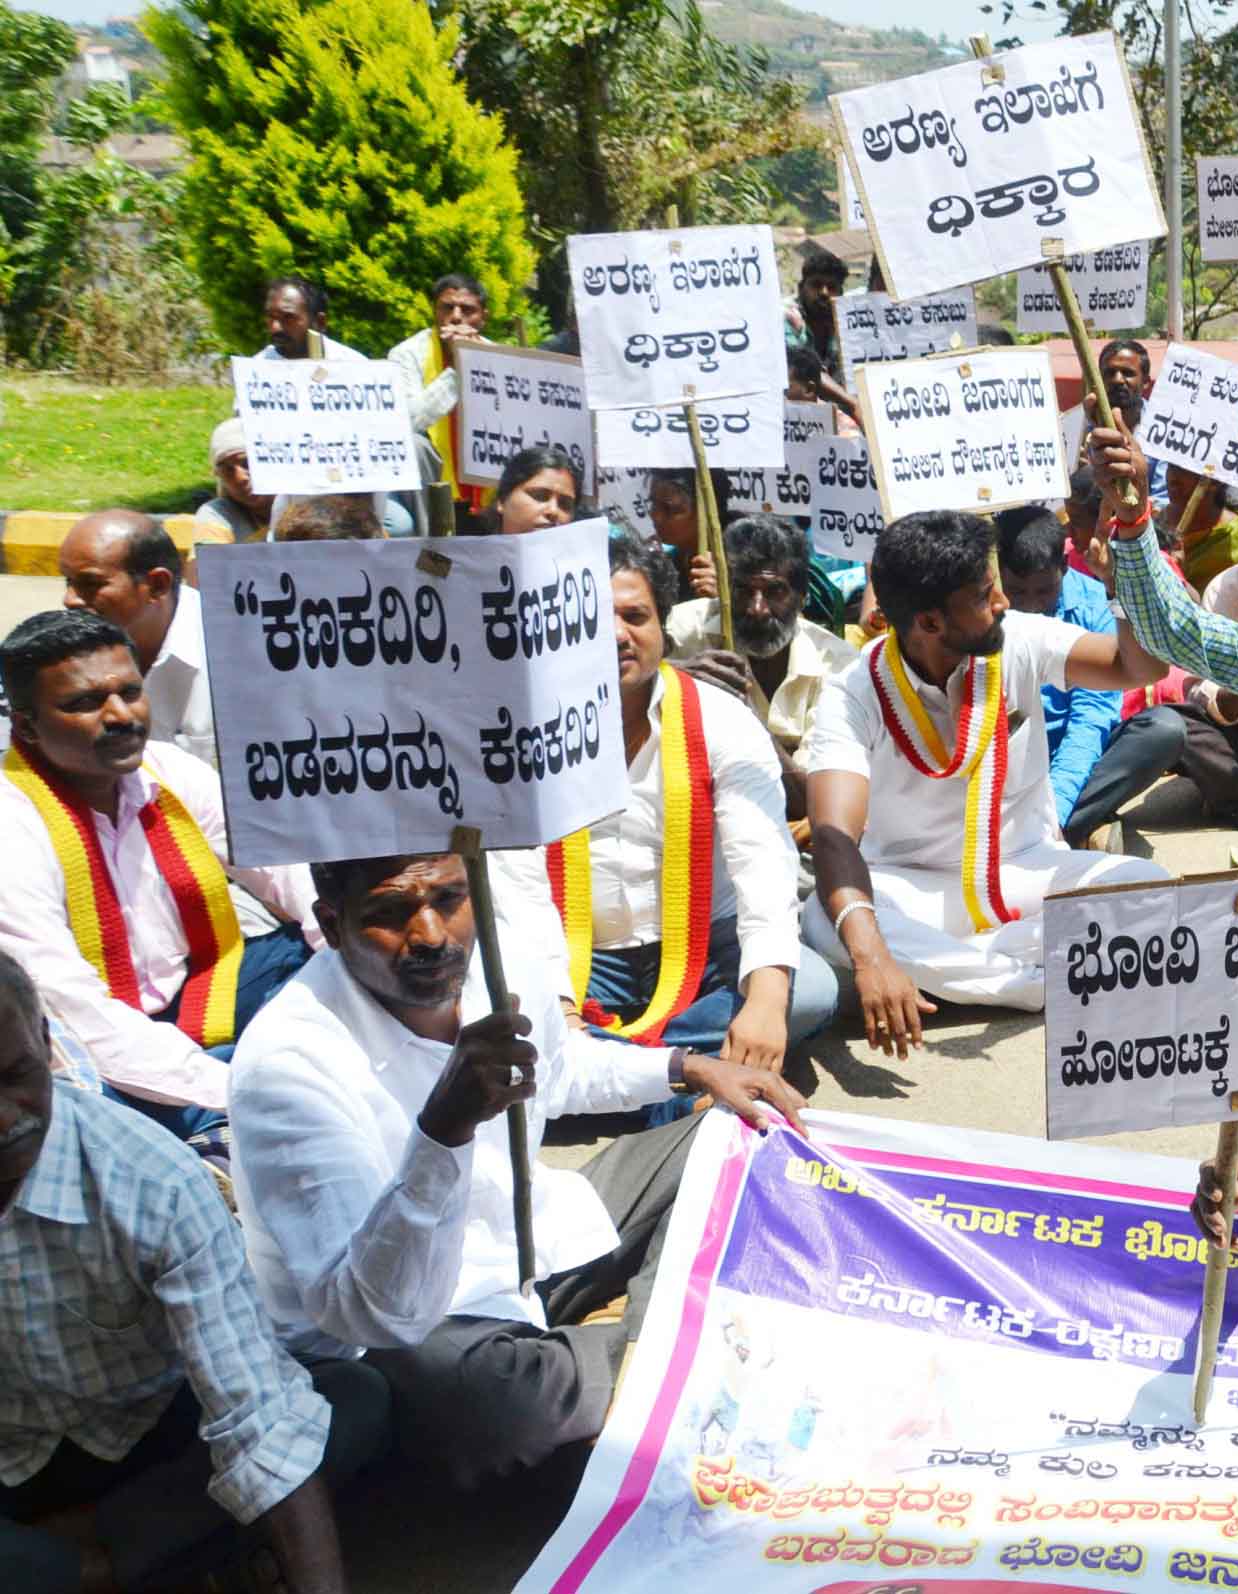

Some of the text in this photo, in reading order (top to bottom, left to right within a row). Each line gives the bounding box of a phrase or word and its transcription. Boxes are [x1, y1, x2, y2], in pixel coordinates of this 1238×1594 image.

[862, 60, 1105, 168] ಅರಣ್ಯ ಇಲಾಖೆಗೆ
[927, 154, 1101, 237] ಧಿಕ್ಕಾರ
[583, 246, 762, 314] ಅರಣ್ಯ ಇಲಾಖೆಗೆ
[624, 318, 751, 372] ಧಿಕ್ಕಾರ
[847, 300, 967, 339] ನಮ್ಮ ಕುಲ ಕಸುಬು
[247, 370, 298, 414] ಭೋವಿ
[470, 366, 582, 412] ನಮ್ಮ ಕುಲ ಕಸುಬು
[884, 369, 1045, 428] ಭೋವಿ ಜನಾಂಗದ
[1168, 360, 1202, 404] ನಮ್ಮ
[1146, 410, 1218, 462] ನಮಗೆ
[892, 448, 945, 483] ಮೇಲಿನ
[234, 557, 599, 673] “ಕೆಣಕದಿರಿ, ಕೆಣಕದಿರಿ
[245, 682, 609, 820] ಬಡವರನ್ನು ಕೆಣಕದಿರಿ”
[1066, 920, 1200, 1006] ಭೋವಿ
[1060, 1013, 1231, 1097] ಹೋರಾಟಕ್ಕೆ
[911, 1194, 1105, 1249] ಕರ್ನಾಟಕ
[837, 1273, 1036, 1340] ಕರ್ನಾಟಕ
[1054, 1318, 1186, 1364] ರಕ್ಷಣಾ
[926, 1446, 1011, 1477] ನಮ್ಮ
[1037, 1452, 1119, 1480] ಕುಲ
[764, 1528, 979, 1570] ಬಡವರಾದ
[998, 1535, 1144, 1573] ಭೋವಿ
